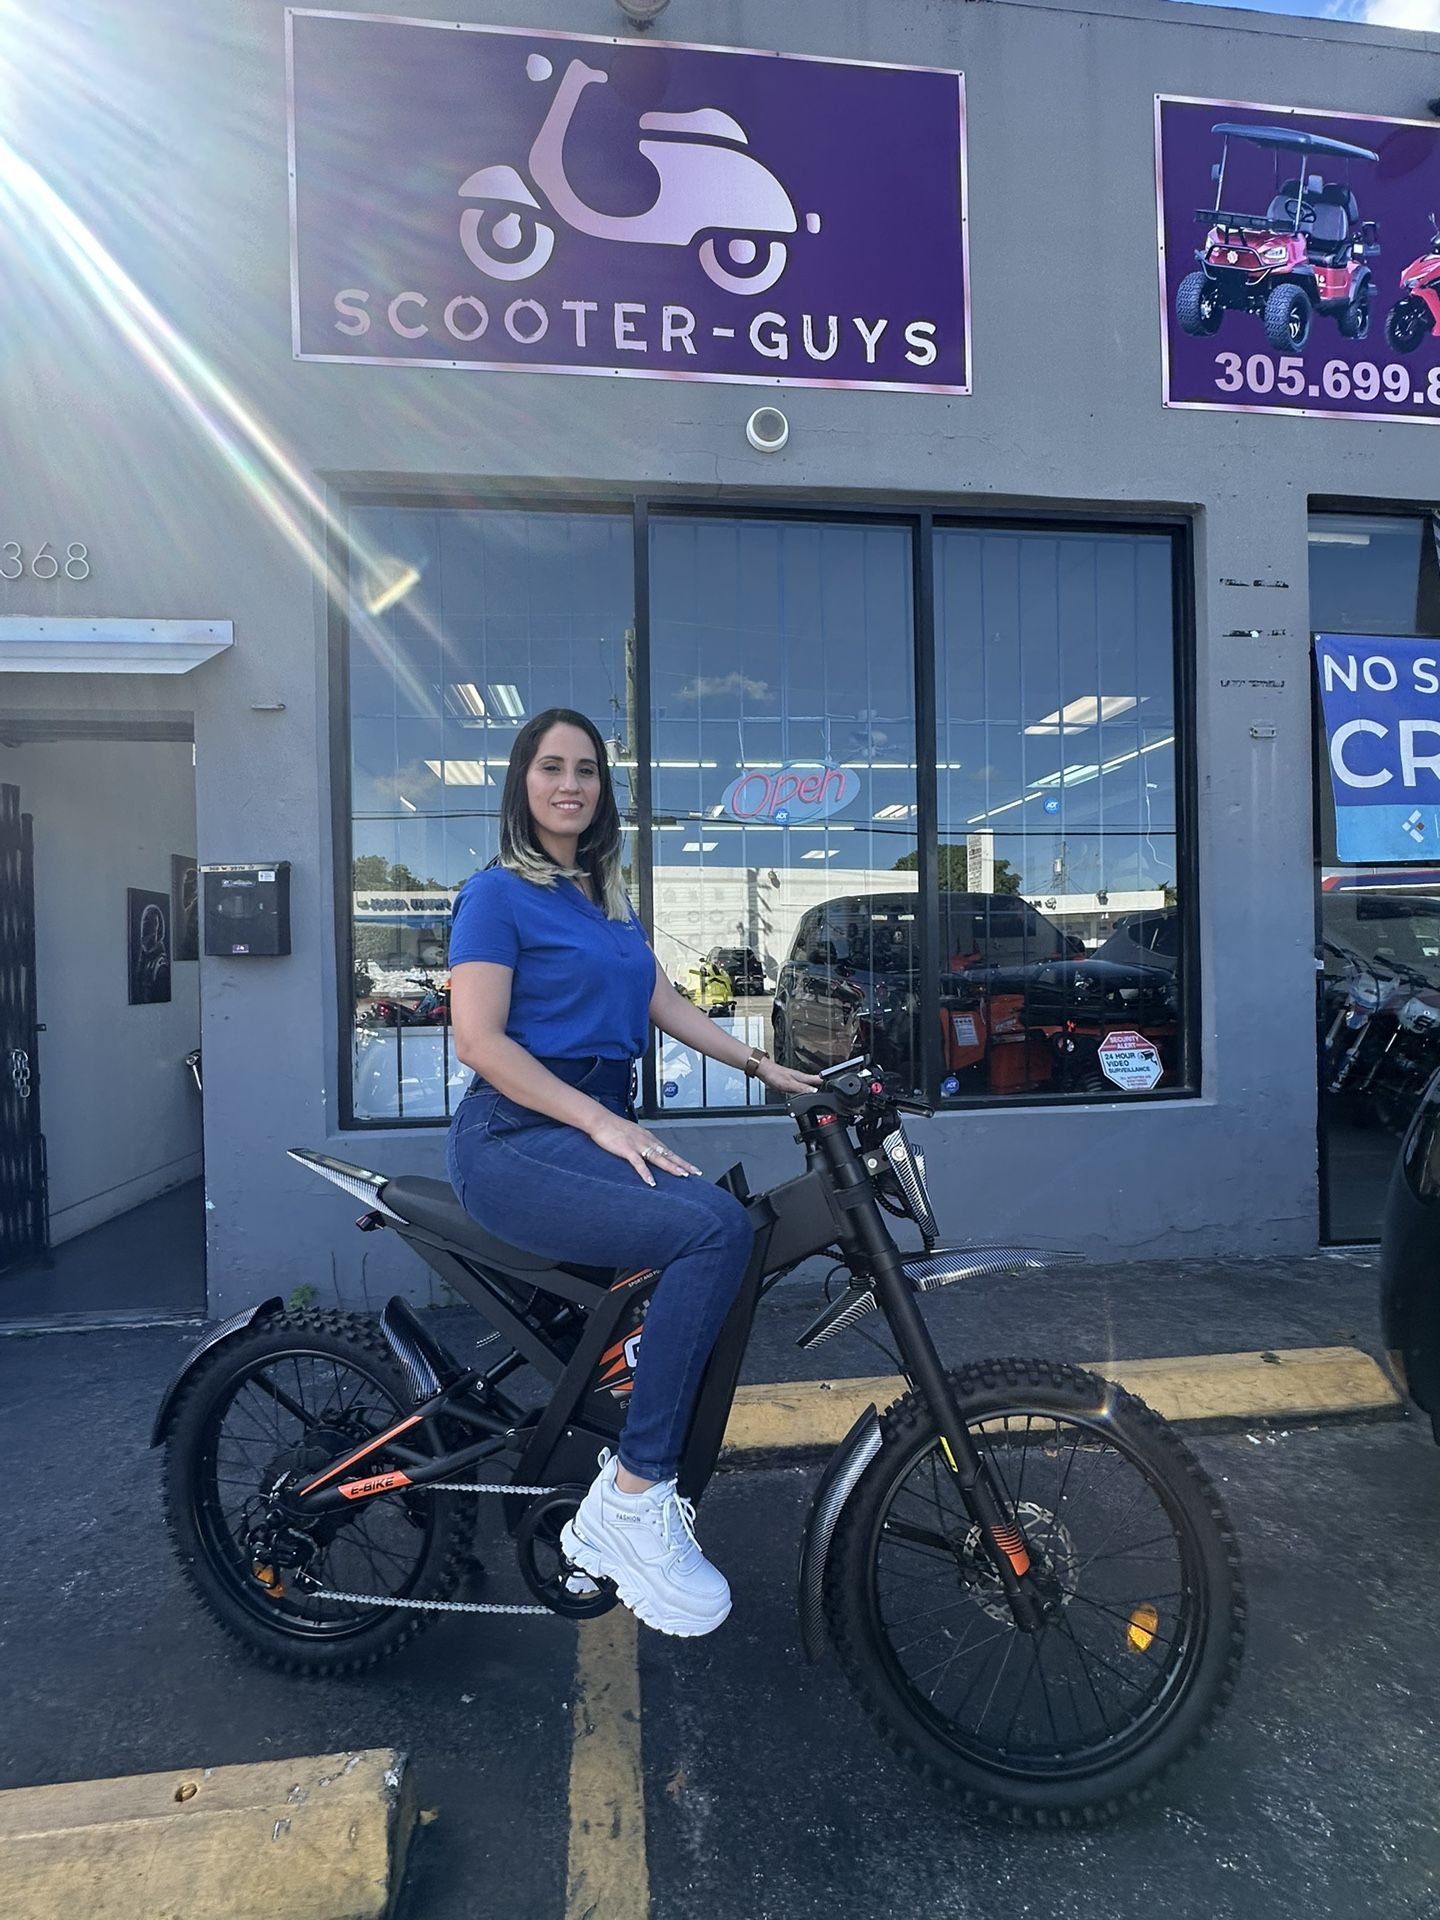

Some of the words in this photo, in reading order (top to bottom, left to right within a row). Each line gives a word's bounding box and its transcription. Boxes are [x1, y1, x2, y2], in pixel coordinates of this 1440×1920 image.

[334, 288, 937, 366] SCOOTER-GUYS
[0, 541, 90, 580] 368
[1323, 654, 1398, 692] NO
[1330, 718, 1440, 788] CR
[732, 768, 846, 818] Open
[1115, 1052, 1136, 1060] HOUR
[351, 1476, 395, 1495] E-BIKE
